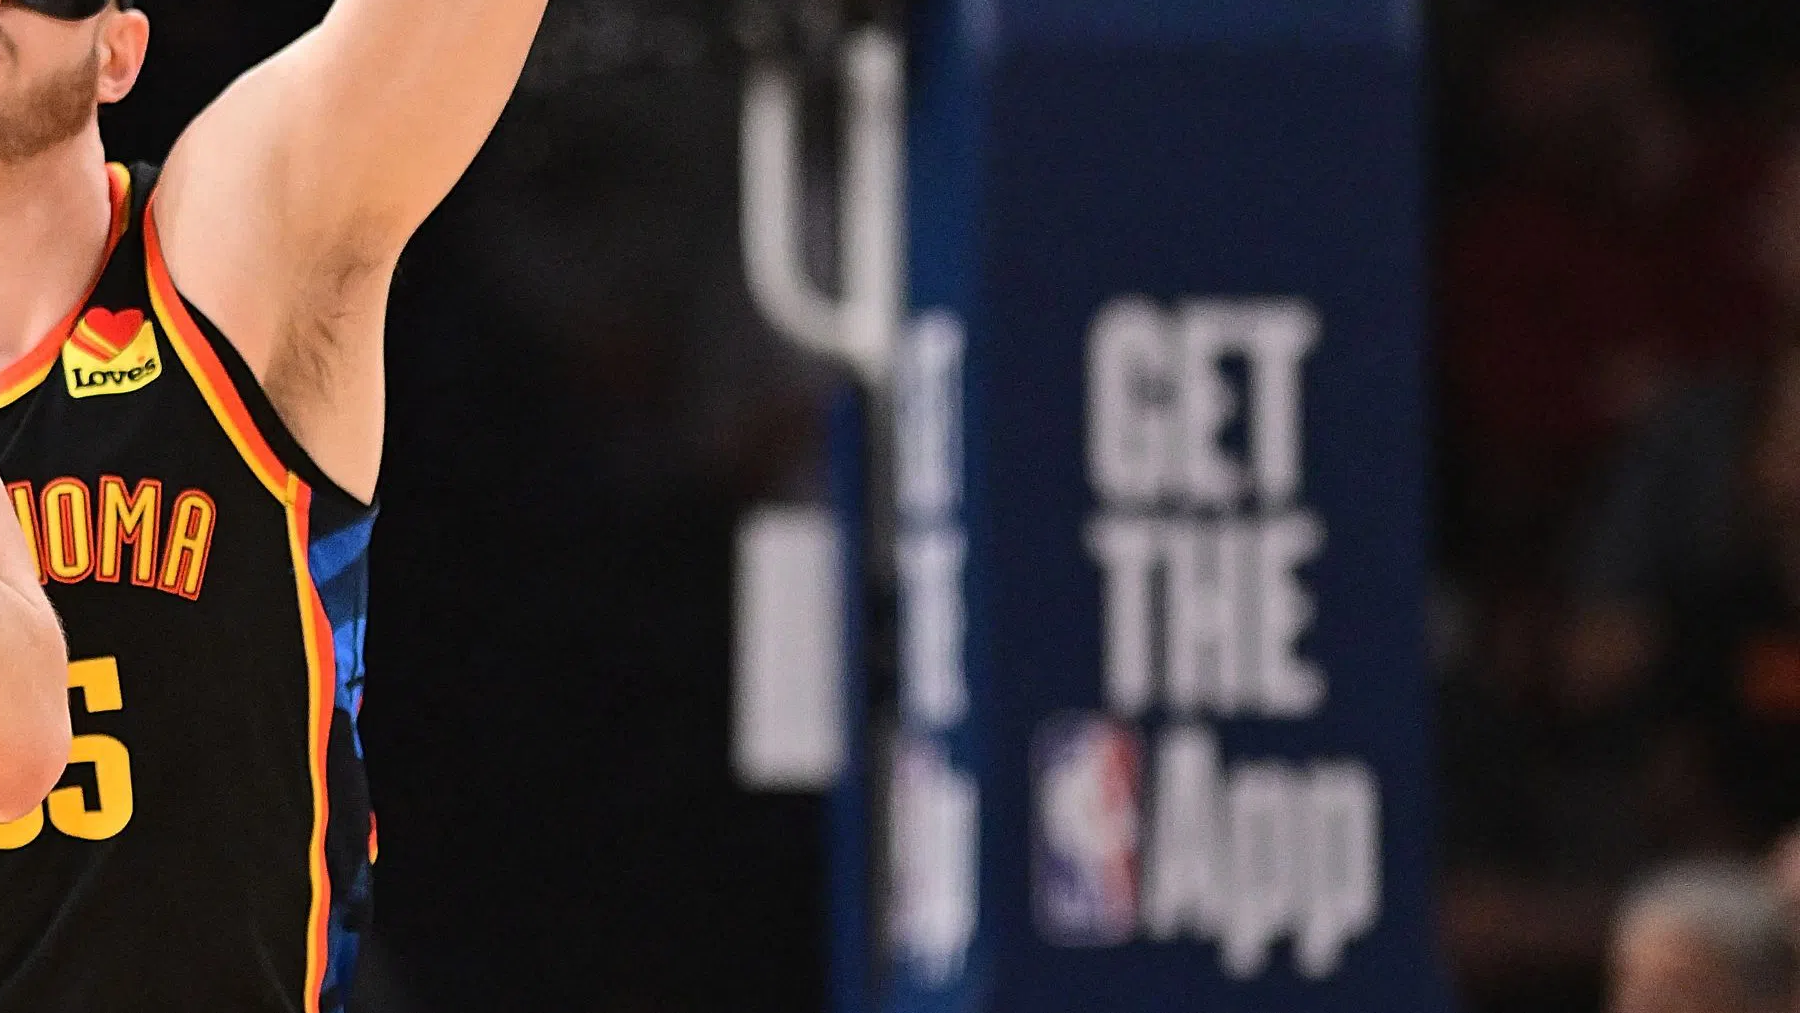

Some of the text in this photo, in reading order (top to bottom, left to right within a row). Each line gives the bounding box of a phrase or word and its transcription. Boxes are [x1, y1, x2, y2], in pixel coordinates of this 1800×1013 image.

[1089, 298, 1320, 500] GET
[1085, 510, 1327, 720] THE
[1146, 725, 1383, 979] App
